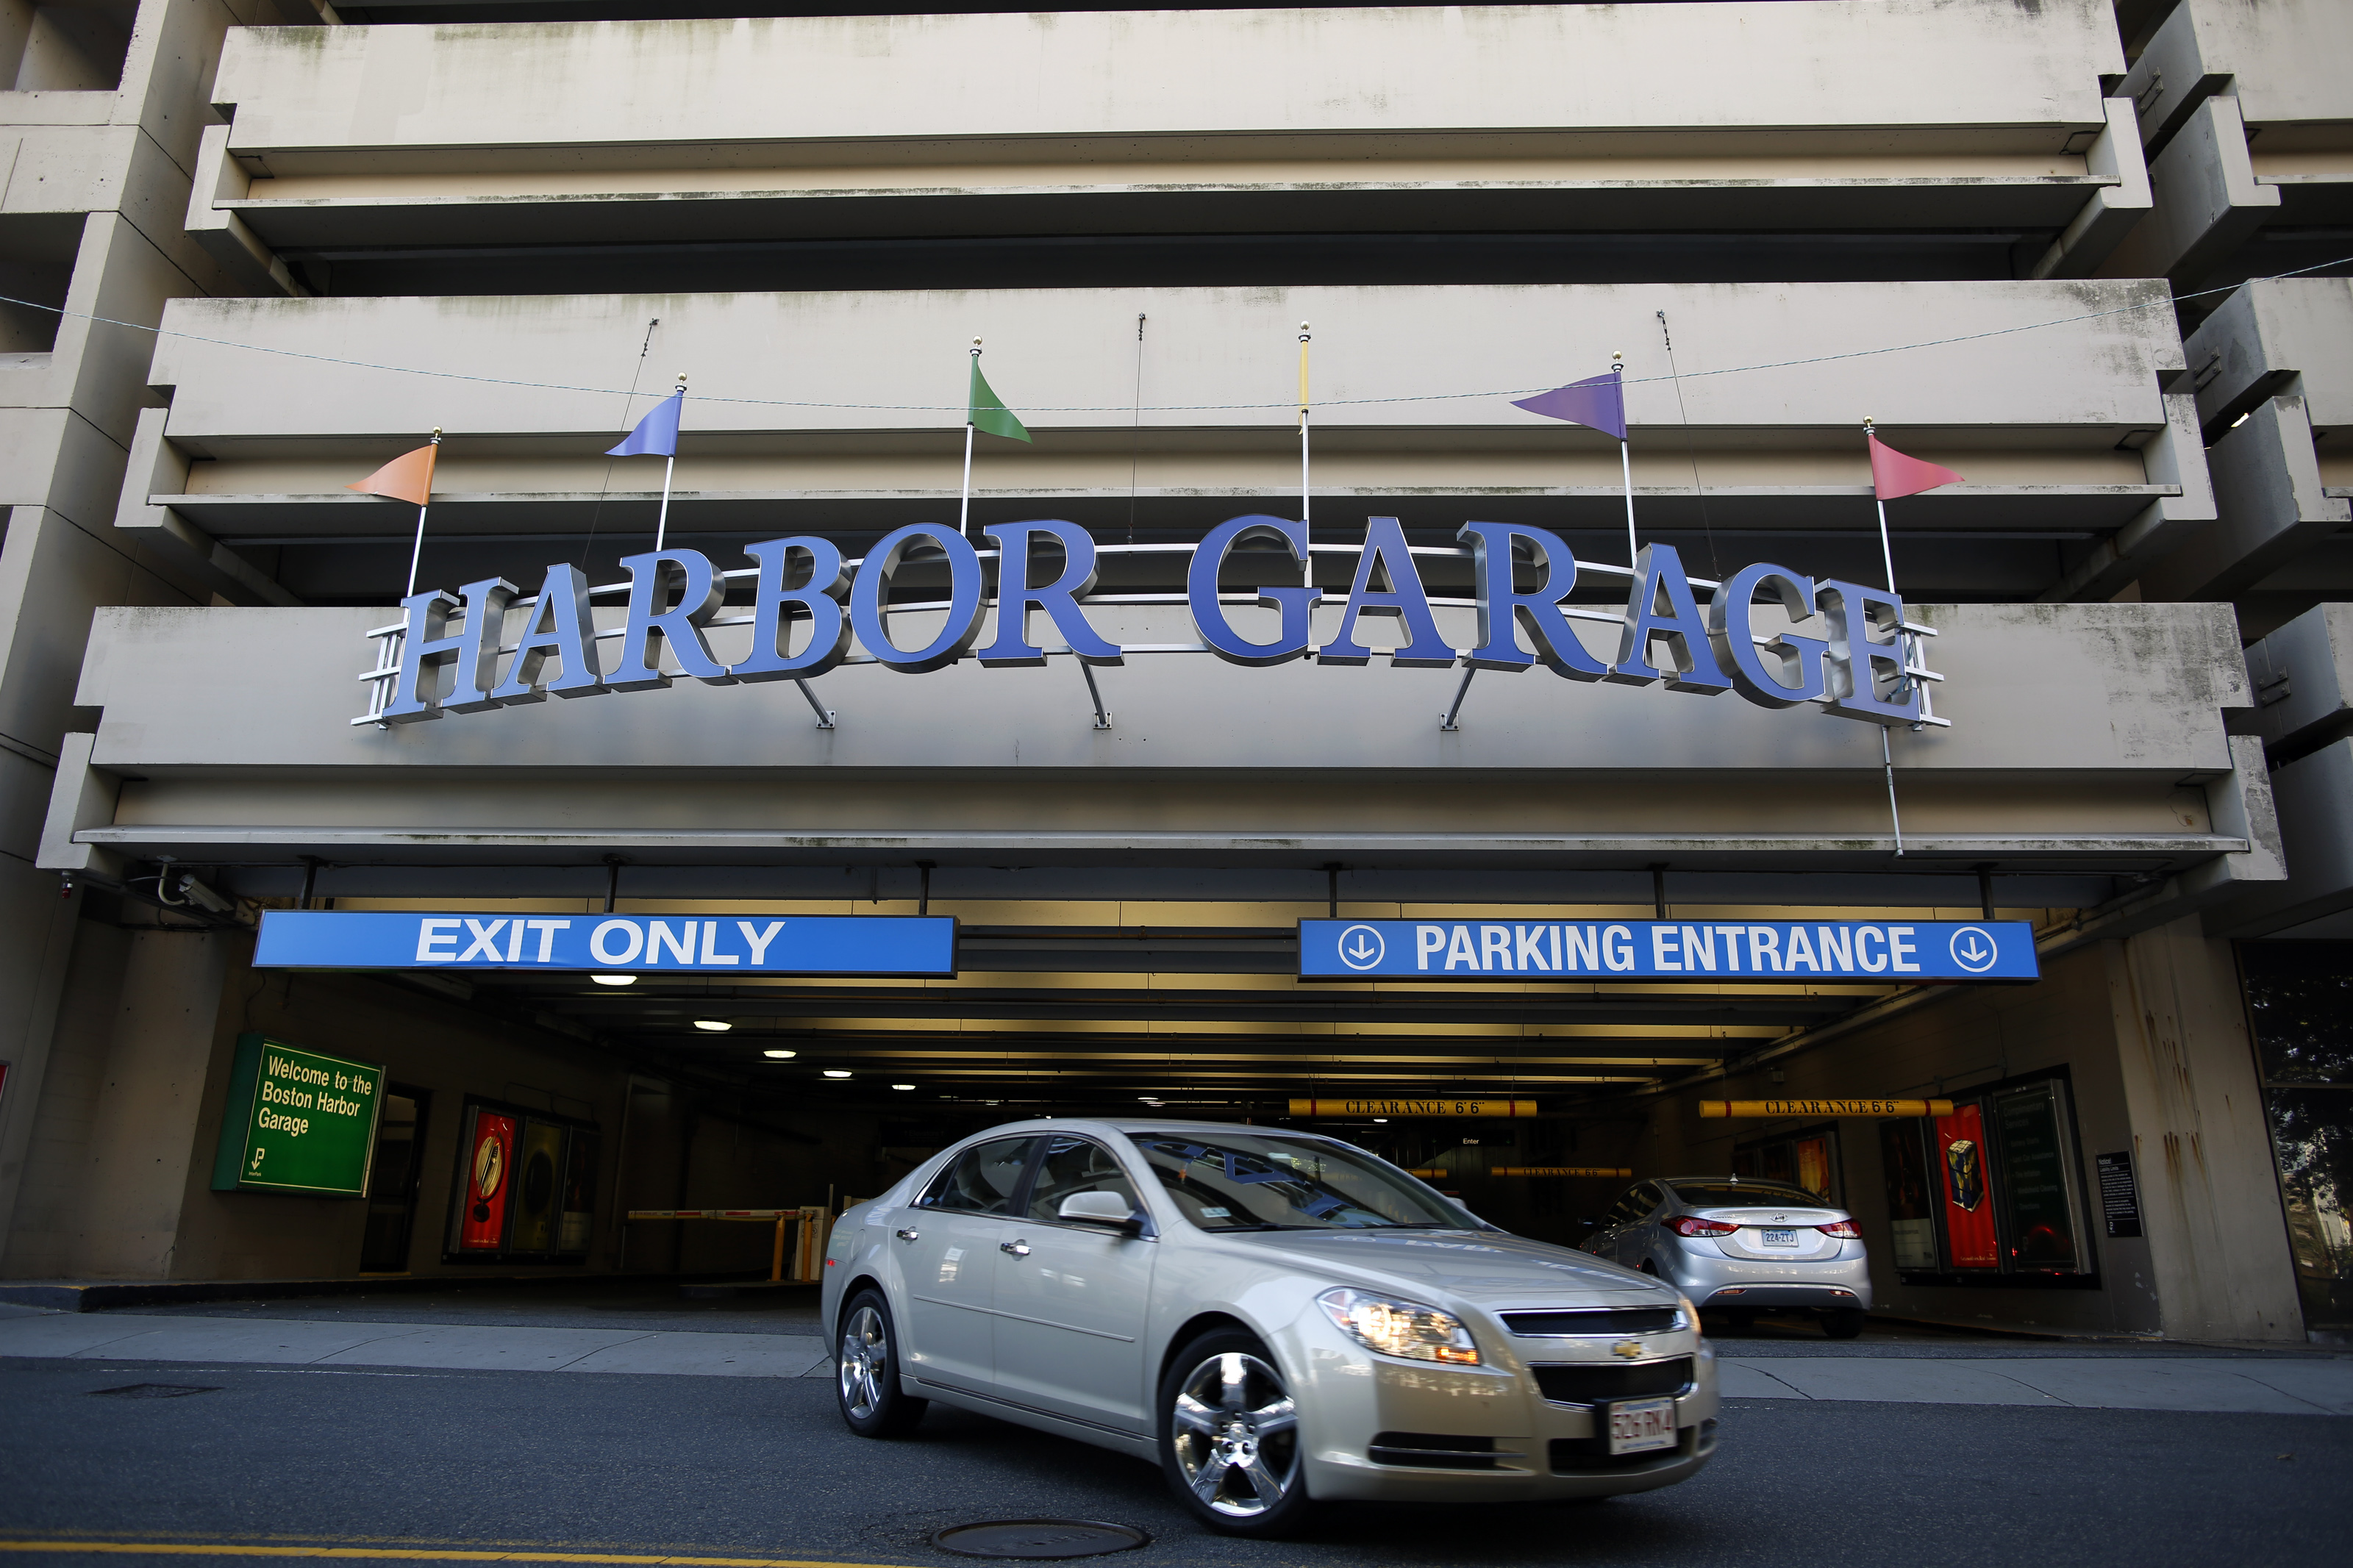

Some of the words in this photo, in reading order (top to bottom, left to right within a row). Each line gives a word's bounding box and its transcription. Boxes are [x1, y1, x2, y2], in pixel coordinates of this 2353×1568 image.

[382, 518, 1124, 723] HARBOR
[1187, 513, 1920, 726] GARAGE
[415, 918, 571, 963] EXIT
[590, 919, 786, 965] ONLY
[1416, 925, 1635, 972] PARKING
[1651, 926, 1921, 973] ENTRANCE
[268, 1055, 329, 1087] Welcome
[335, 1070, 348, 1090] to
[352, 1074, 372, 1095] the
[262, 1081, 313, 1109] Boston
[316, 1091, 361, 1117] Harbor
[1346, 1100, 1447, 1114] CLEARANCE
[1765, 1100, 1869, 1114] CLEARANCE
[258, 1106, 309, 1137] Garage
[2005, 1117, 2029, 1130] Services
[1523, 1167, 1580, 1176] CLEARANCE
